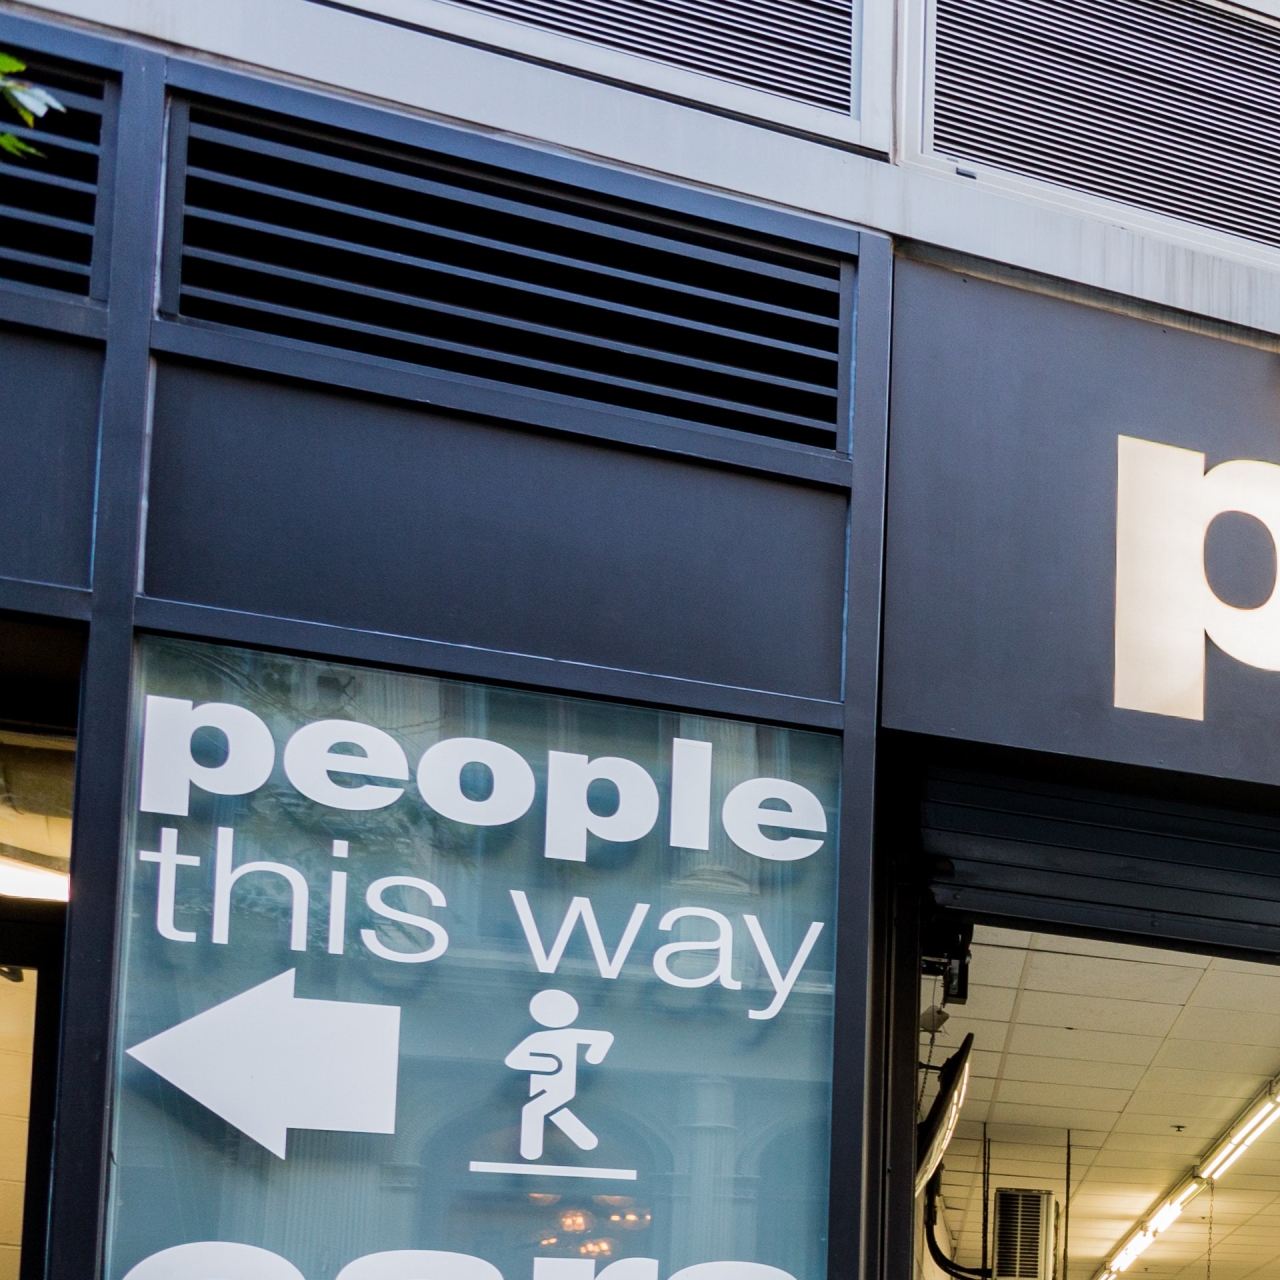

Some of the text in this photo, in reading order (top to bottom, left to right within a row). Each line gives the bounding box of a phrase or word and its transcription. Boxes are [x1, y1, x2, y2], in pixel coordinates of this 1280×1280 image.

[140, 695, 828, 862] people
[139, 827, 825, 1021] this way
